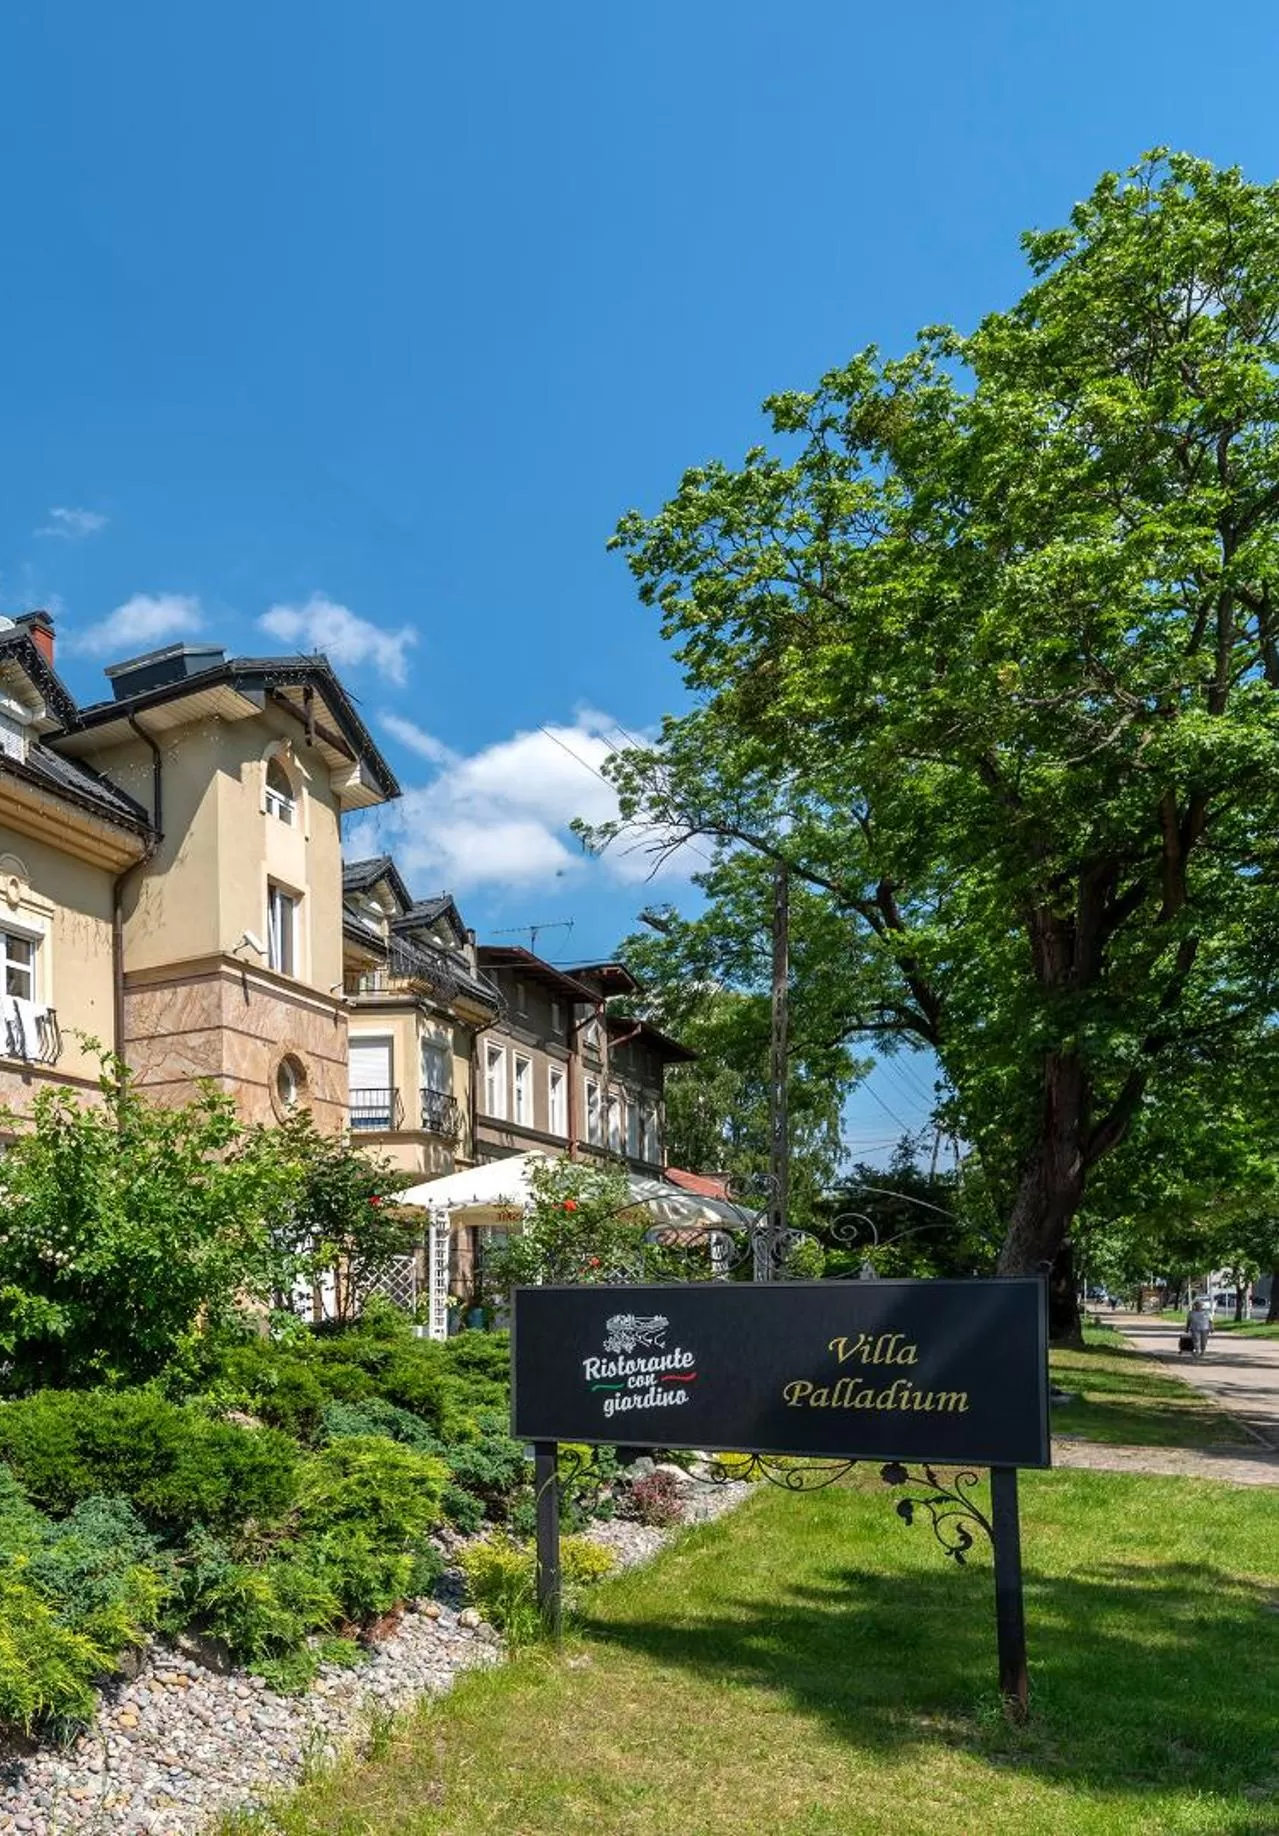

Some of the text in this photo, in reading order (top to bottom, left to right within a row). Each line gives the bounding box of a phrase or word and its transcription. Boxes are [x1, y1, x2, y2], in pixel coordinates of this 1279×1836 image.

[582, 1347, 696, 1381] Ristorante
[828, 1333, 919, 1366] Villa
[627, 1373, 658, 1389] con
[782, 1378, 971, 1413] Palladium
[603, 1386, 690, 1418] giardino
